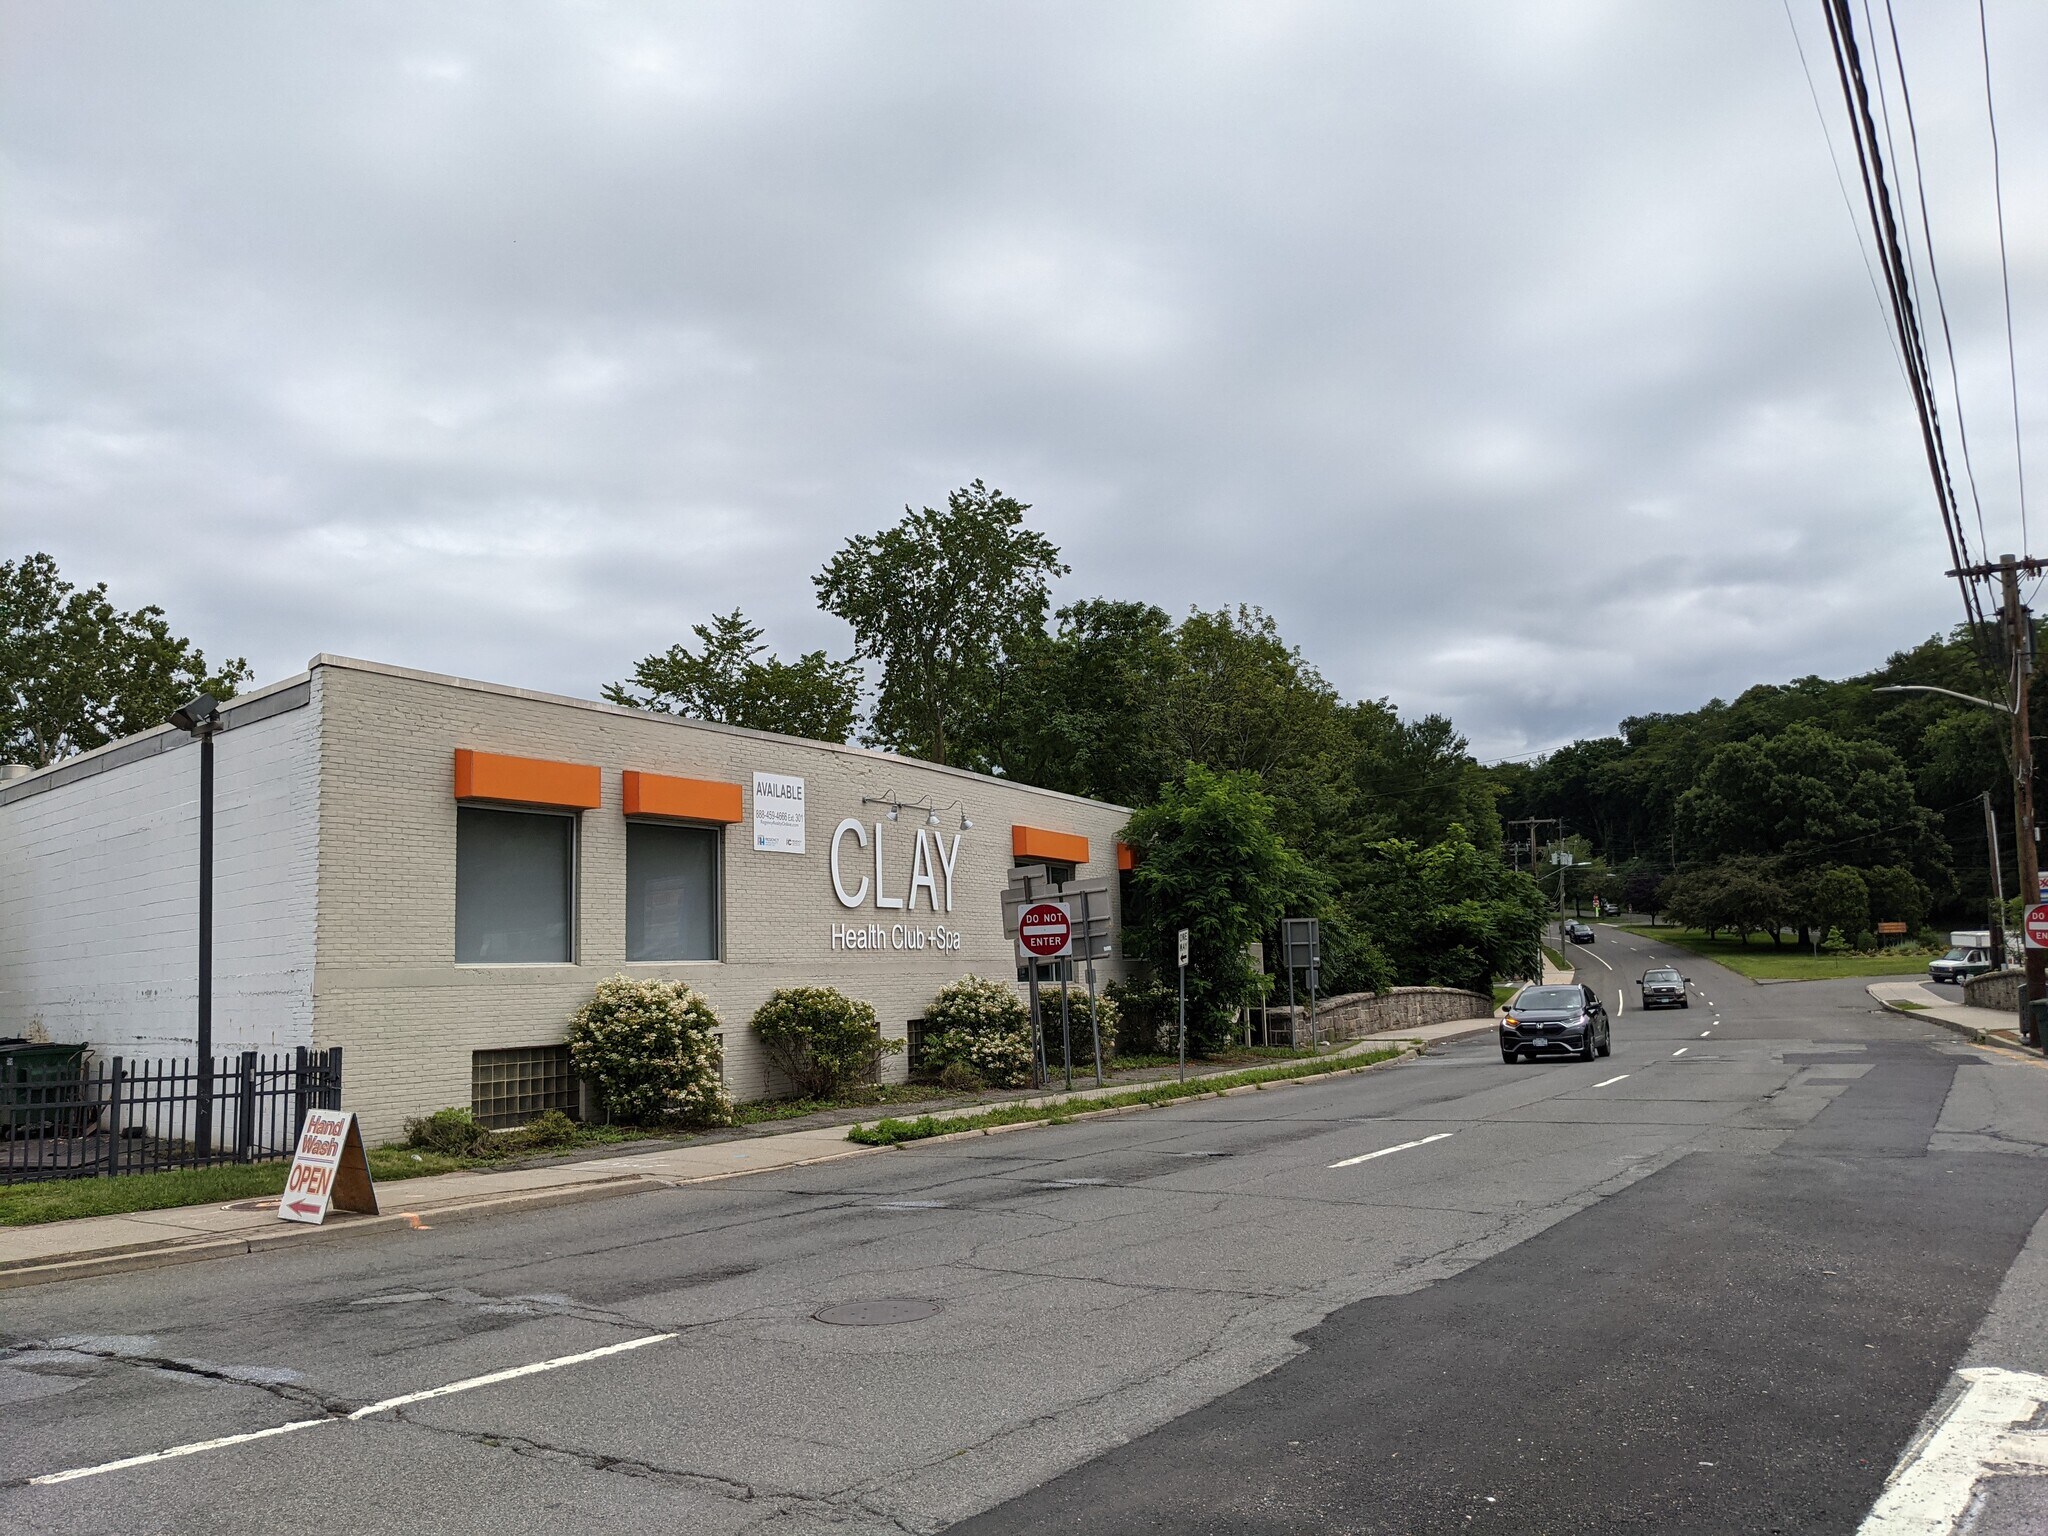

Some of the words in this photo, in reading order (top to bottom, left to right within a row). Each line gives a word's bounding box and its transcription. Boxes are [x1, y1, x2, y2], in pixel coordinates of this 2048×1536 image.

[756, 781, 802, 800] AVAILABLE
[831, 818, 961, 911] CLAY
[1026, 914, 1039, 924] DO
[1043, 913, 1062, 922] NOT
[831, 923, 886, 950] Health
[891, 924, 924, 950] Club
[1030, 936, 1062, 946] ENTER
[306, 1115, 345, 1136] Hand
[302, 1134, 338, 1156] Wash
[288, 1163, 333, 1196] OPEN
